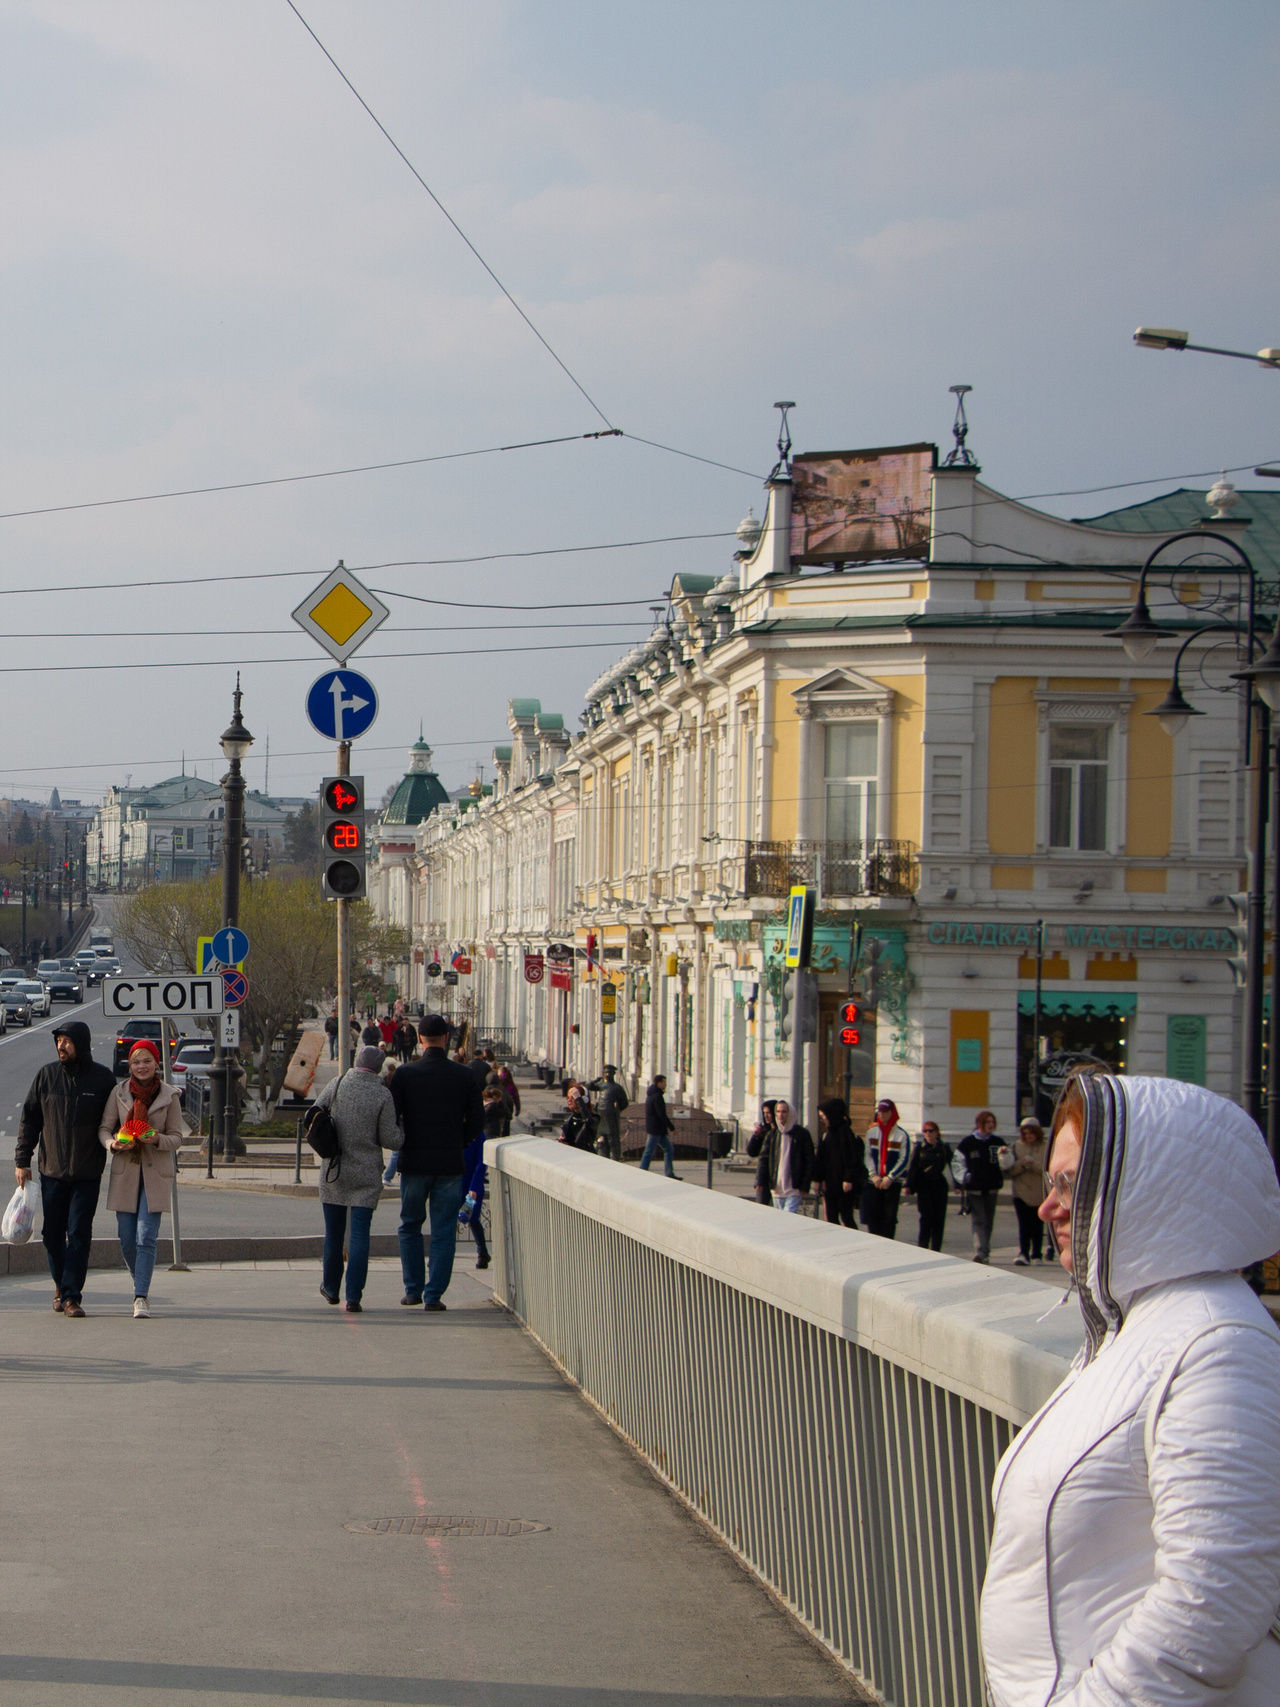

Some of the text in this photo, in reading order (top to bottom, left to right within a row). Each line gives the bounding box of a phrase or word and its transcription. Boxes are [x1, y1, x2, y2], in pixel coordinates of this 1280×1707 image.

[333, 825, 359, 848] 28
[928, 922, 1238, 950] СЛАДКАЯ МАСТЕРСКАЯ
[112, 981, 213, 1012] СТОП
[842, 1029, 859, 1044] 95
